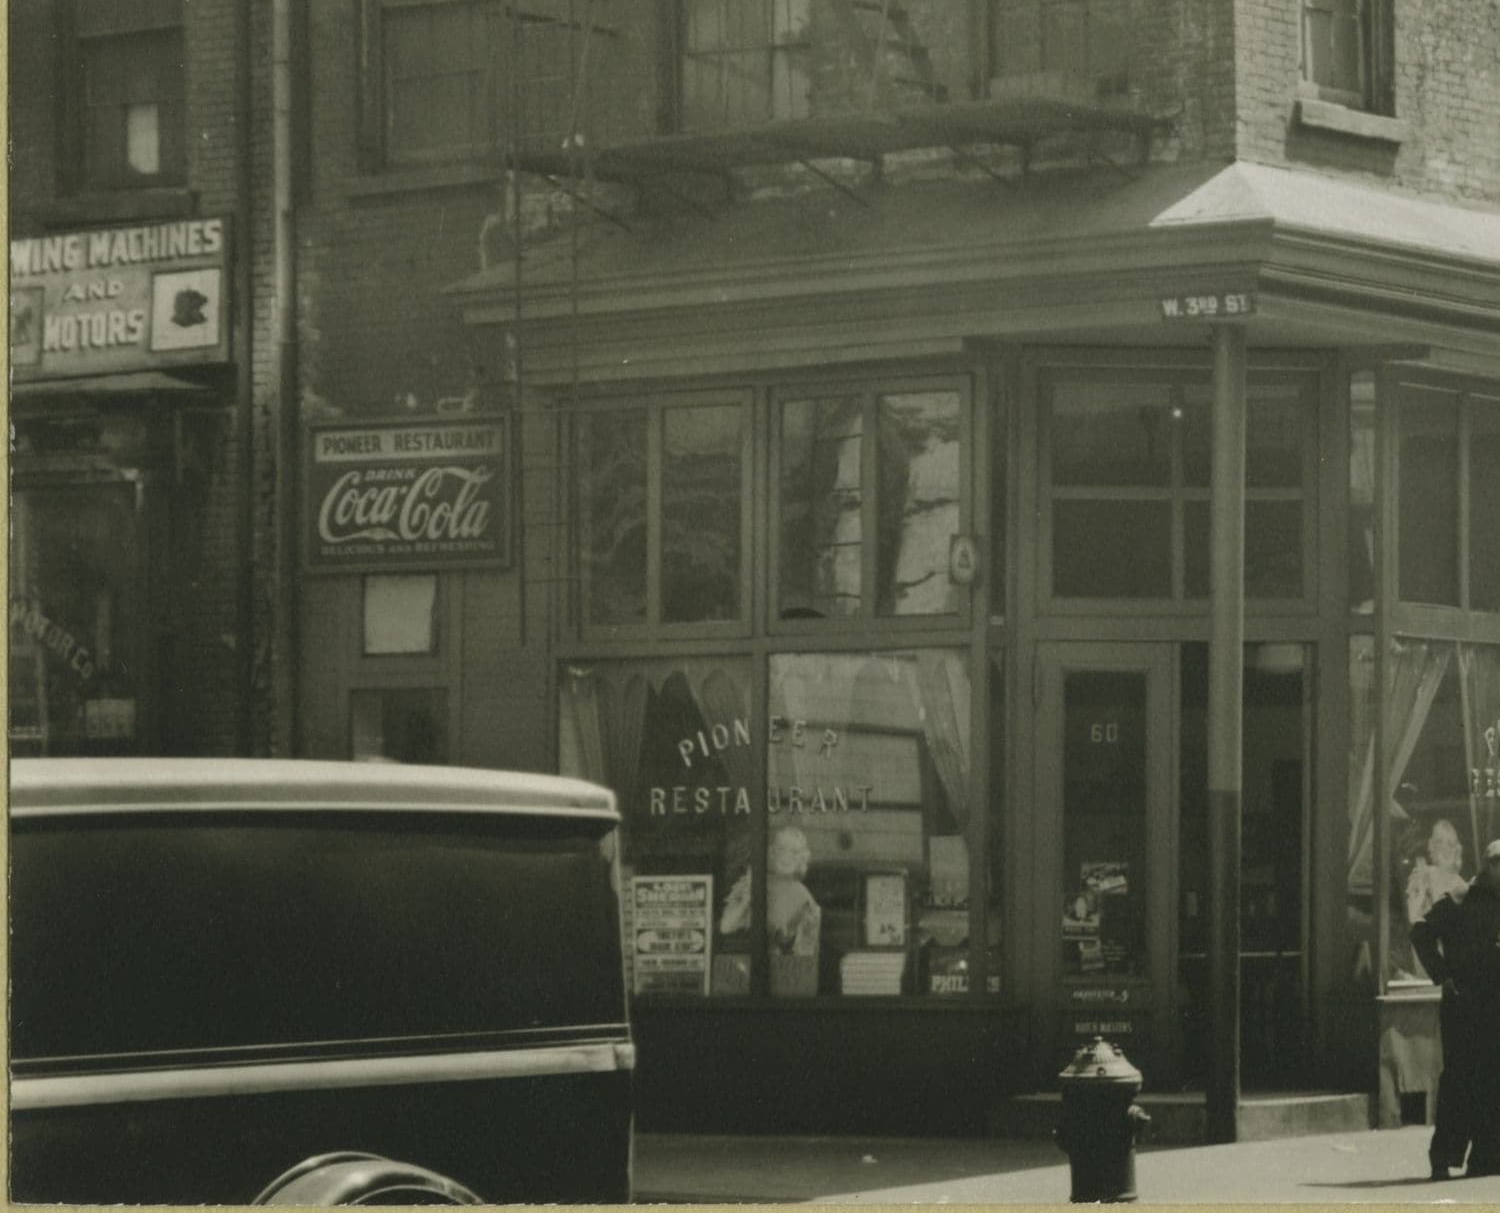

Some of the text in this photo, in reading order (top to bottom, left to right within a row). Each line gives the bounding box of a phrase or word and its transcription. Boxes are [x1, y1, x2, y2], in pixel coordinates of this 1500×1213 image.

[87, 219, 222, 267] MACHINES
[63, 279, 125, 303] AND
[43, 309, 146, 353] MOTORS
[322, 429, 497, 455] PIONEER RESTAURANT
[363, 467, 418, 482] DRINK
[677, 714, 840, 768] PIONEER
[1091, 722, 1118, 743] 60
[649, 785, 873, 816] RESTAURANT
